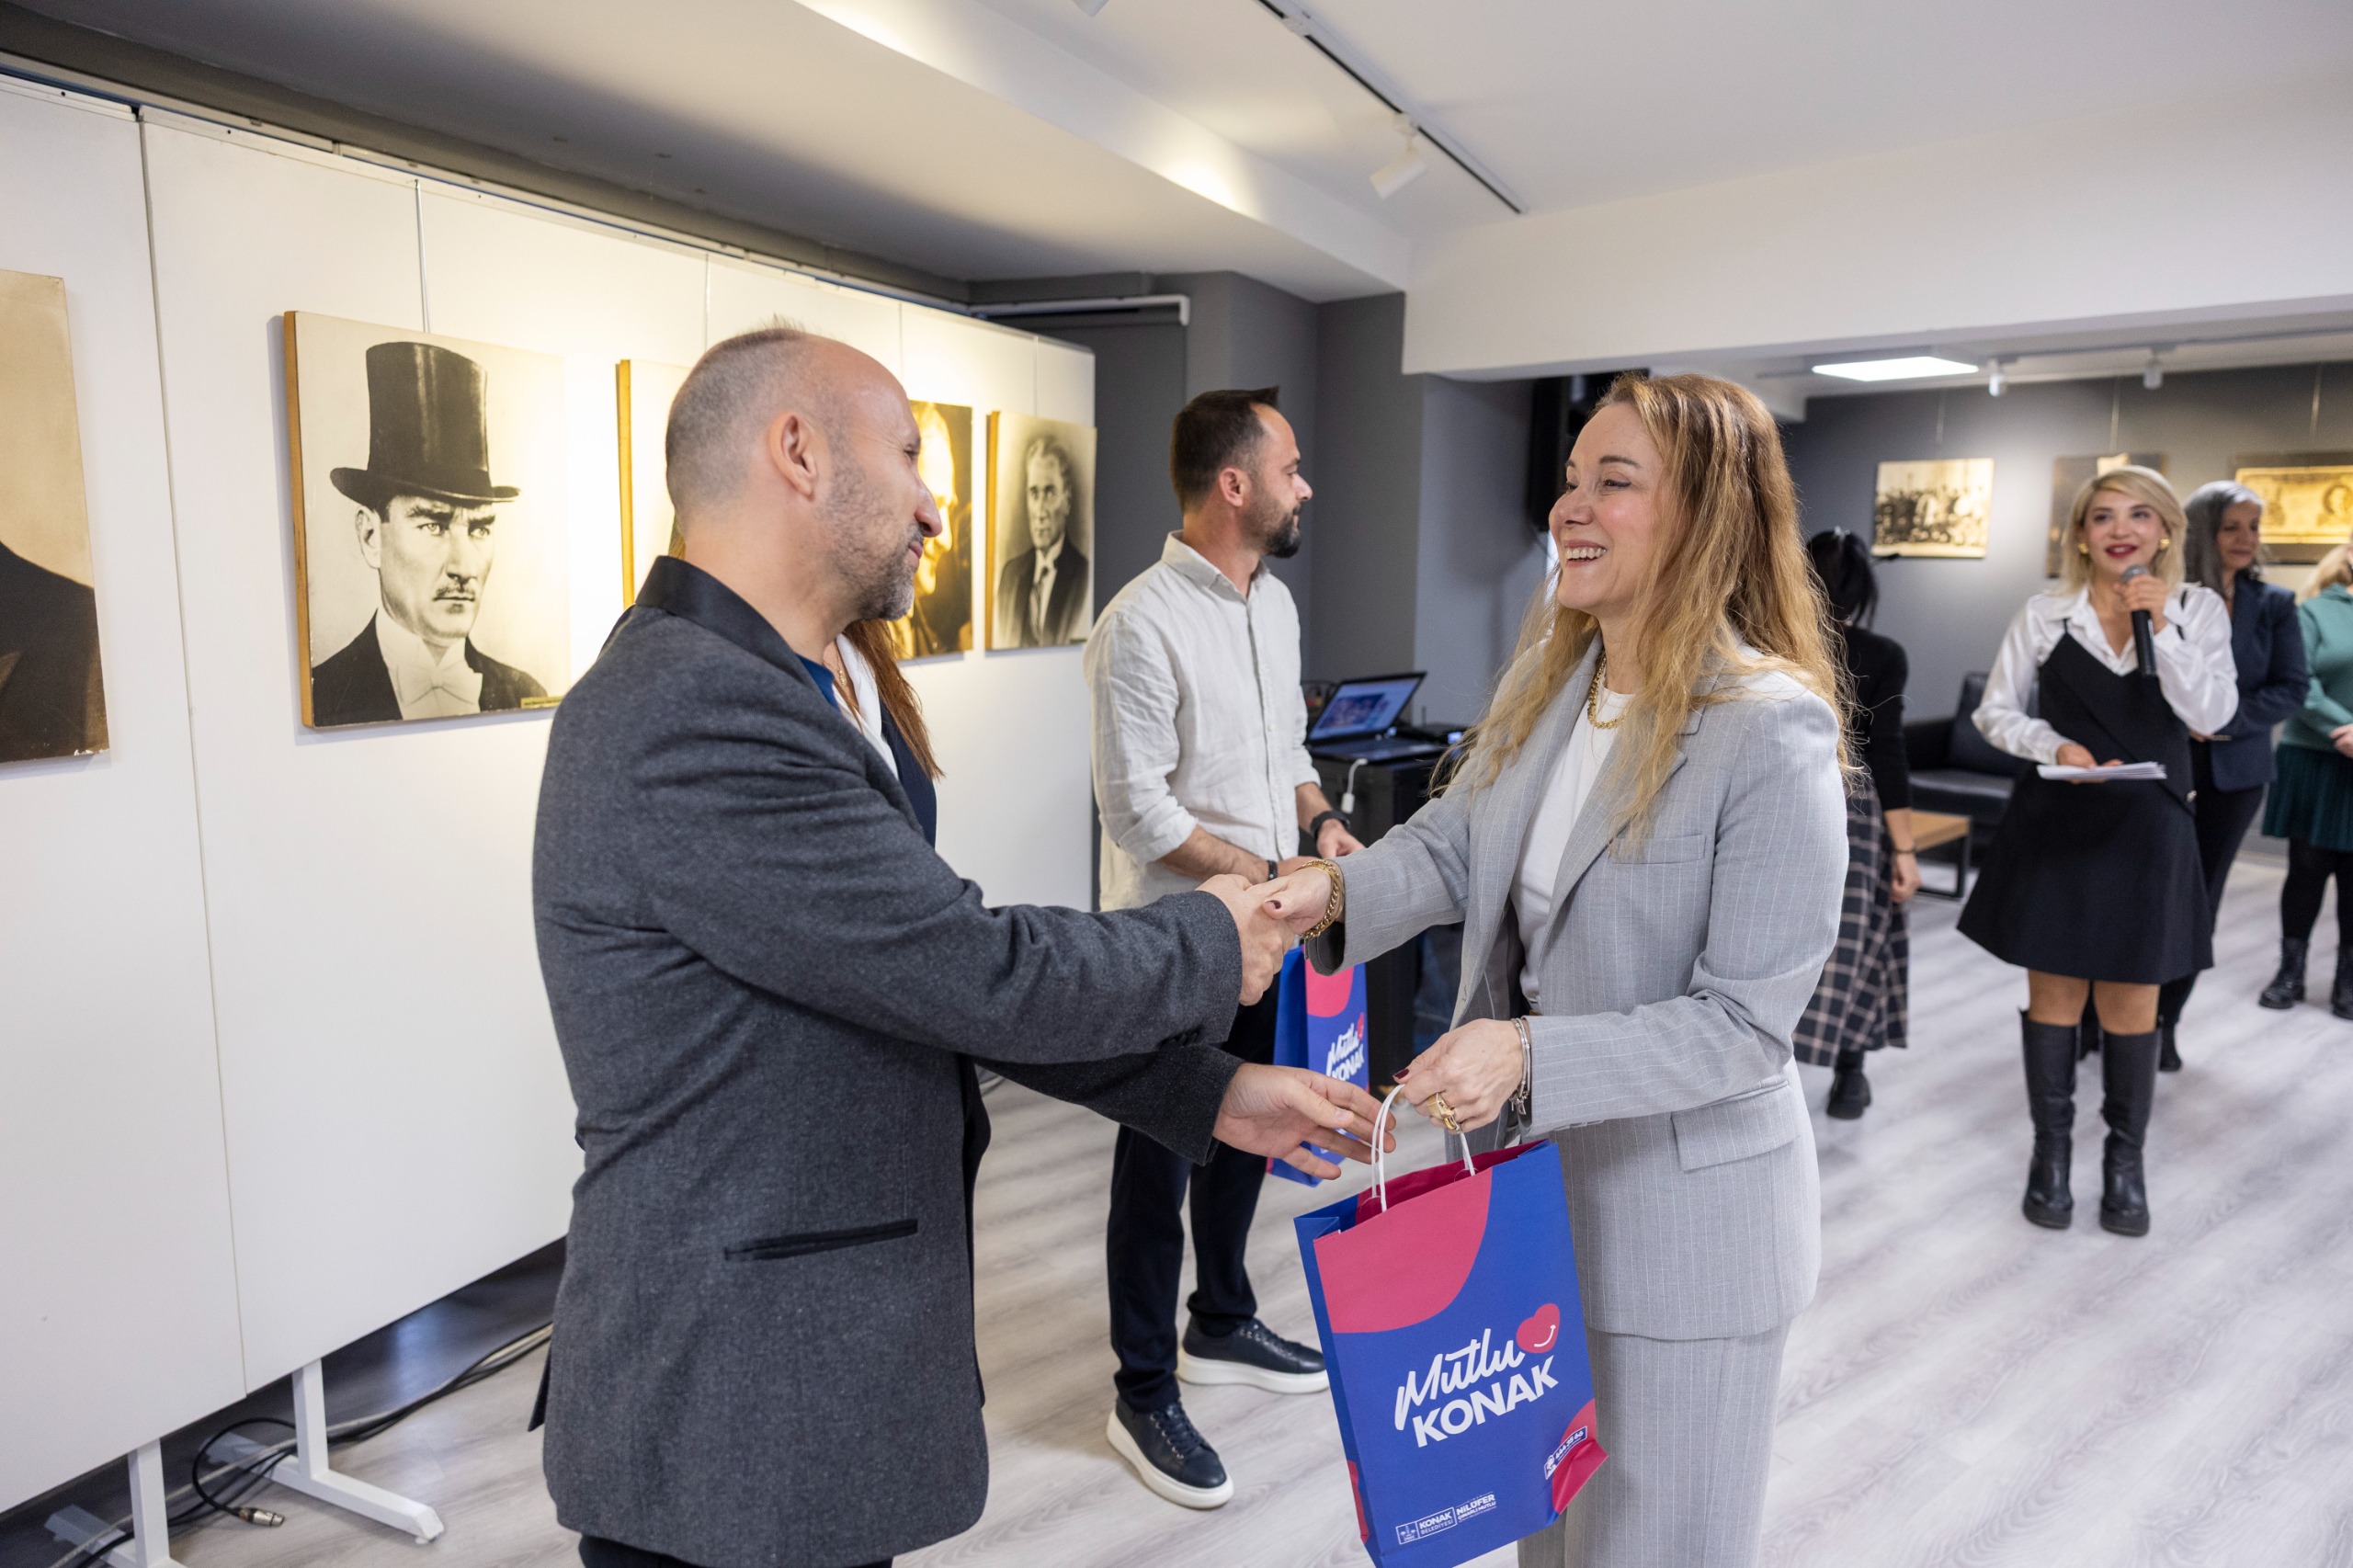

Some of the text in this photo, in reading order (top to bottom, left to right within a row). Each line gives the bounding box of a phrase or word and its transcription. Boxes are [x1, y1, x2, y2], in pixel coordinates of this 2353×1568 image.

[1394, 1328, 1525, 1430] Mutlu
[1412, 1355, 1559, 1448] KONAK
[1419, 1512, 1452, 1529] KONAK
